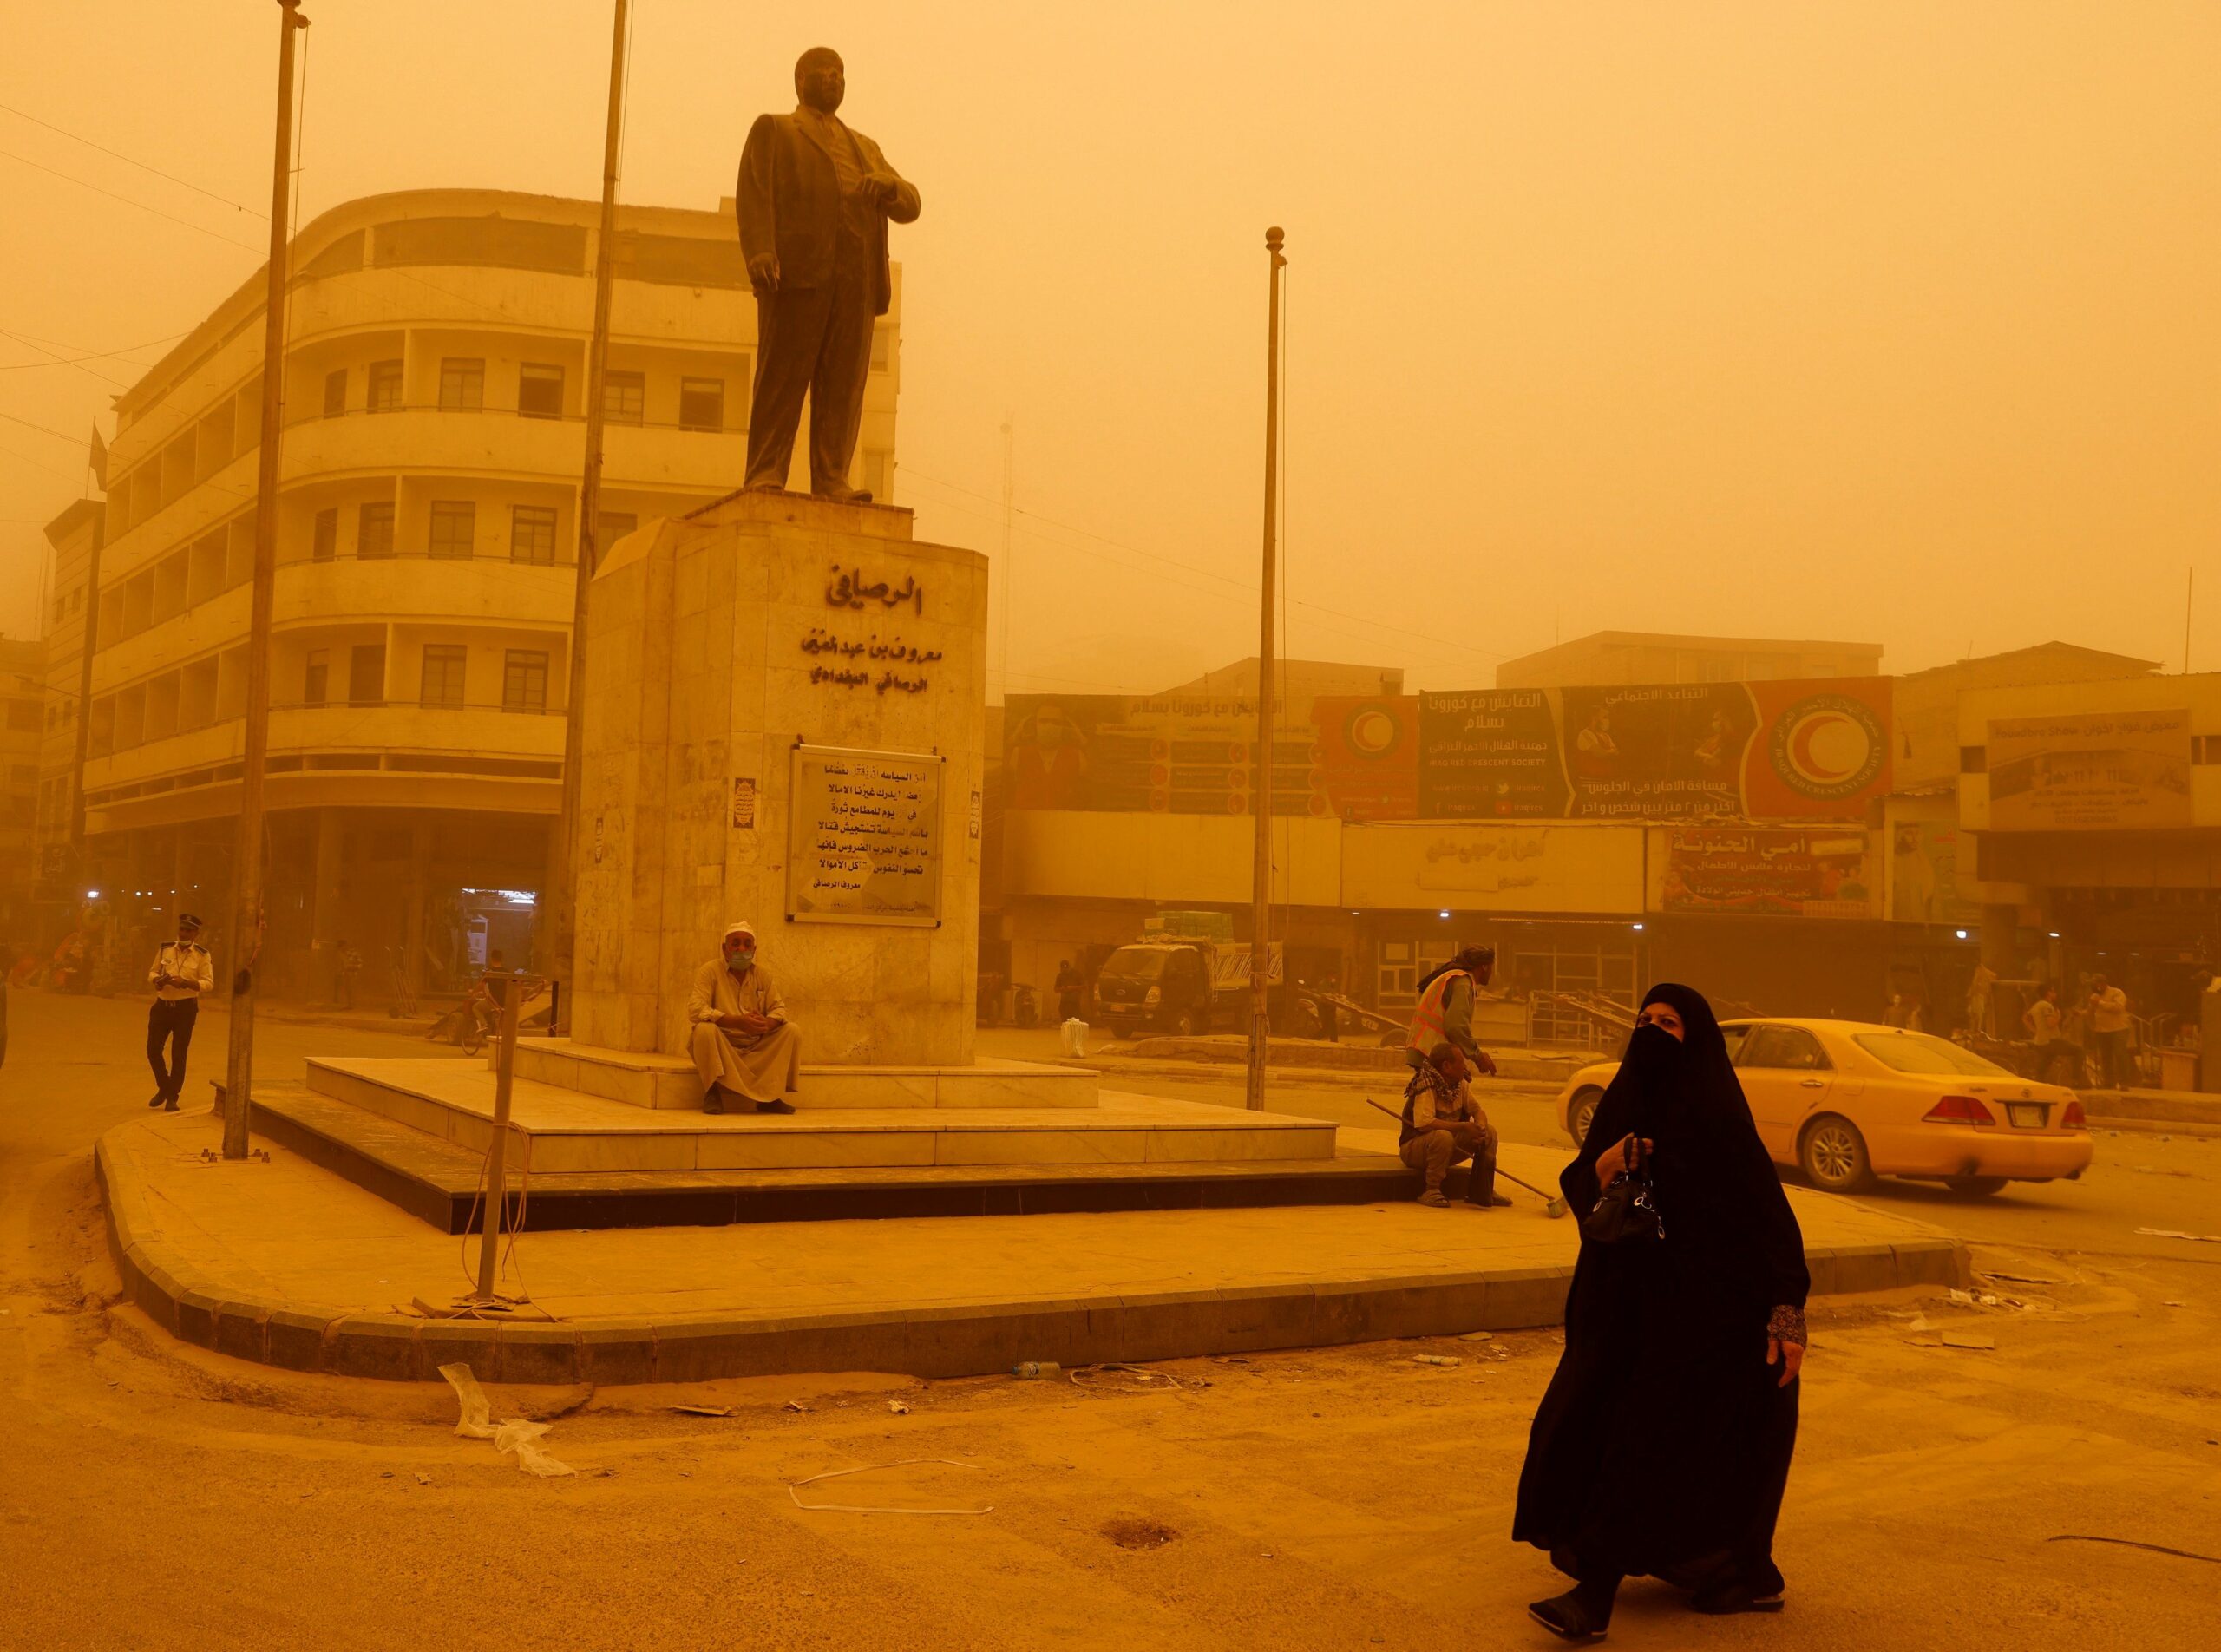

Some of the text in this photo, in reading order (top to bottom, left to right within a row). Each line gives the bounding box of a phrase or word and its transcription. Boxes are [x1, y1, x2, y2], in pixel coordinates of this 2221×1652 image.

[826, 565, 922, 617] الرصافي
[840, 642, 866, 658] عبد
[868, 634, 889, 659] بن
[889, 637, 942, 664] معروف
[875, 672, 927, 695] الرصافي
[1428, 693, 1541, 712] التعايش مع كورونا
[1605, 688, 1708, 707] التباعد الاجتماعي
[1130, 700, 1169, 718] بسلام
[1172, 699, 1210, 717] كورونا
[1213, 702, 1228, 718] مع
[1464, 715, 1505, 732] بسلام
[1467, 758, 1509, 767] CRESCENT
[1588, 780, 1630, 795] الجلوس
[1632, 783, 1651, 797] في
[1688, 780, 1727, 791] مسافة
[850, 805, 881, 817] للمطامع
[882, 810, 895, 820] يوم
[1609, 801, 1641, 814] شخص
[1642, 803, 1661, 815] بين
[1664, 802, 1681, 814] متر
[1694, 802, 1711, 814] من
[839, 843, 871, 854] الضروس
[1672, 833, 1805, 861] أمي الحنونة
[1697, 861, 1737, 871] الاطفال
[841, 881, 861, 890] معروف
